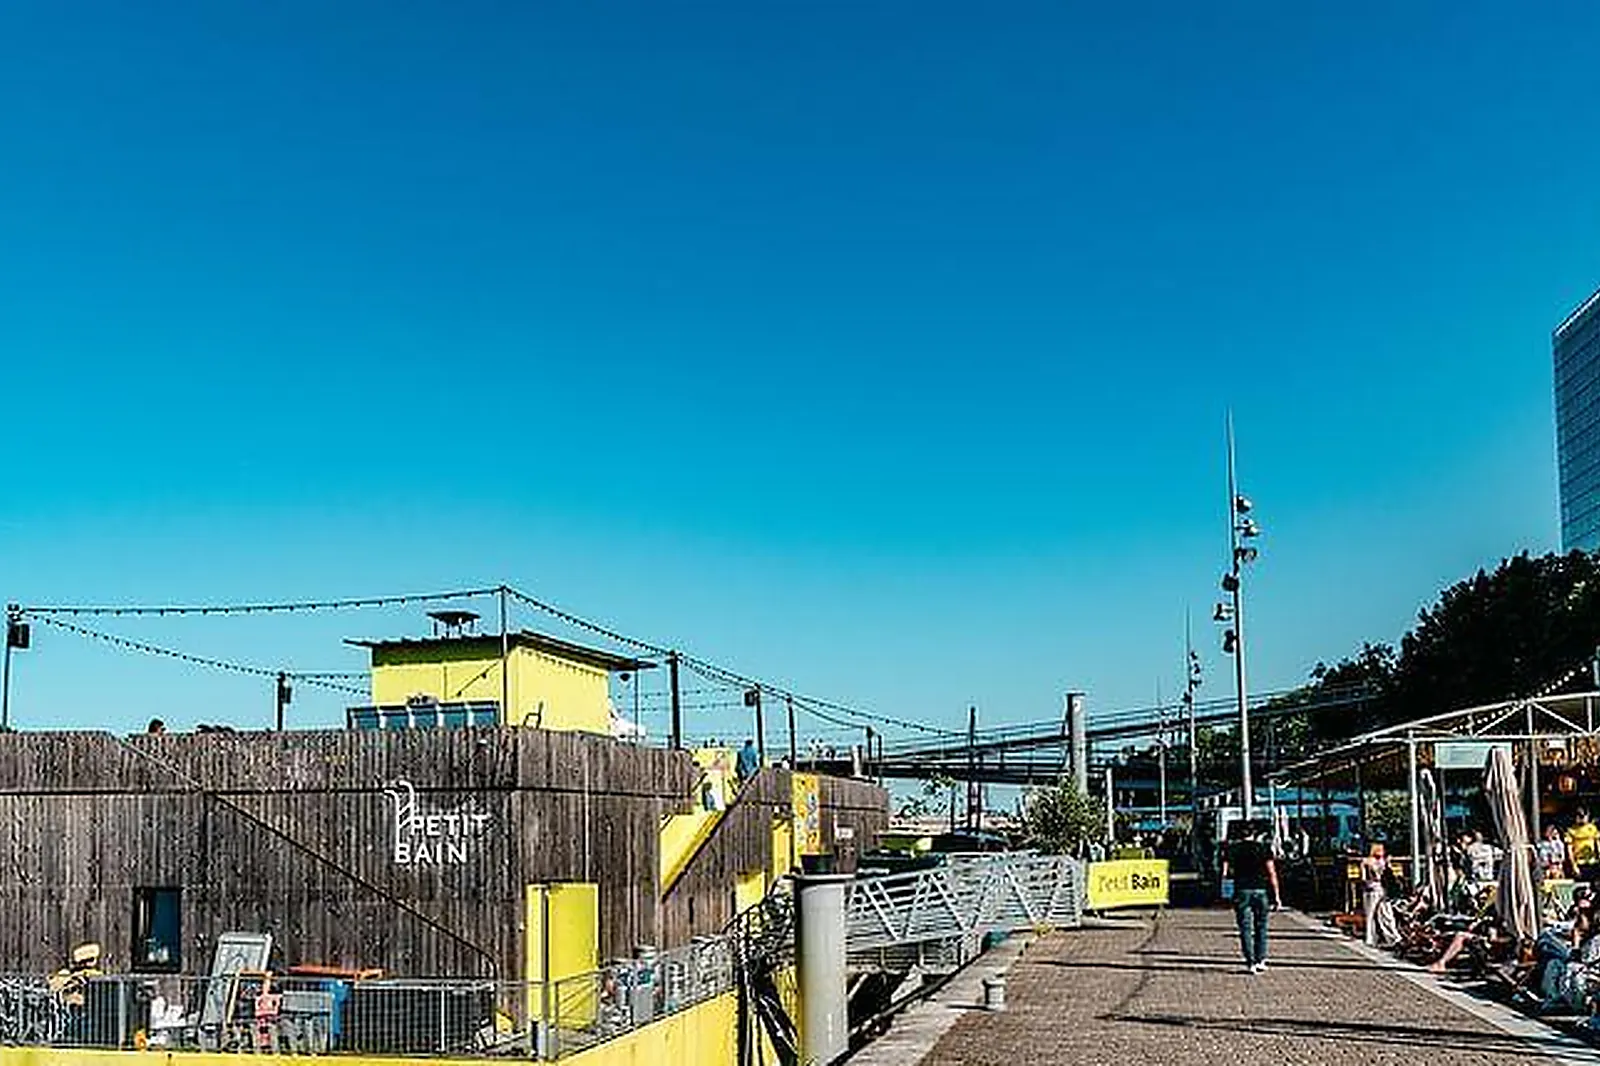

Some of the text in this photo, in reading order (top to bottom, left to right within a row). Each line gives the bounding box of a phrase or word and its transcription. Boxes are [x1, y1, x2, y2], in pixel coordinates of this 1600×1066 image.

[410, 813, 490, 836] PETIT
[395, 842, 467, 864] BAIN
[1131, 871, 1160, 890] Bain
